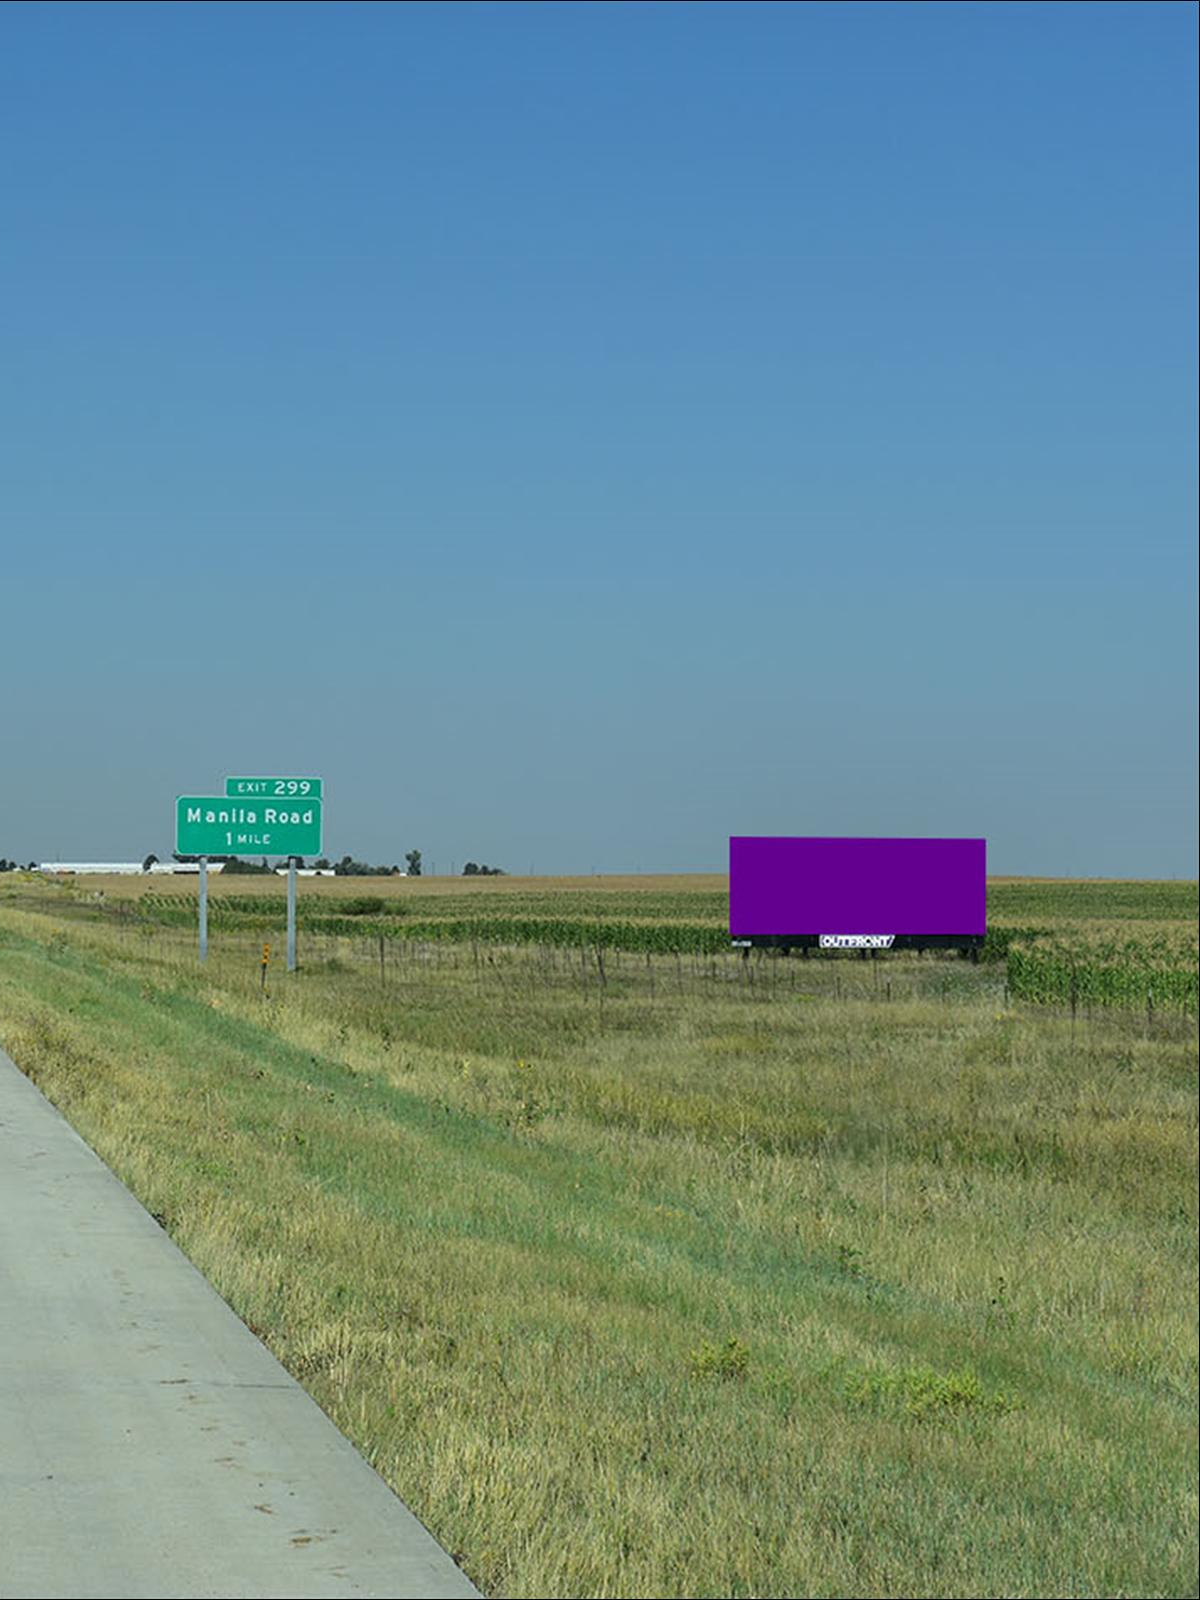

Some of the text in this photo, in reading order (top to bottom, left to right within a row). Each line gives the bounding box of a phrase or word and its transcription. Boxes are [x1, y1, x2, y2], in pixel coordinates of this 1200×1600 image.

[237, 781, 311, 795] EXIT 299
[187, 807, 313, 823] Manila Road
[226, 832, 271, 846] 1 MILE
[821, 935, 892, 947] OUTFRONT
